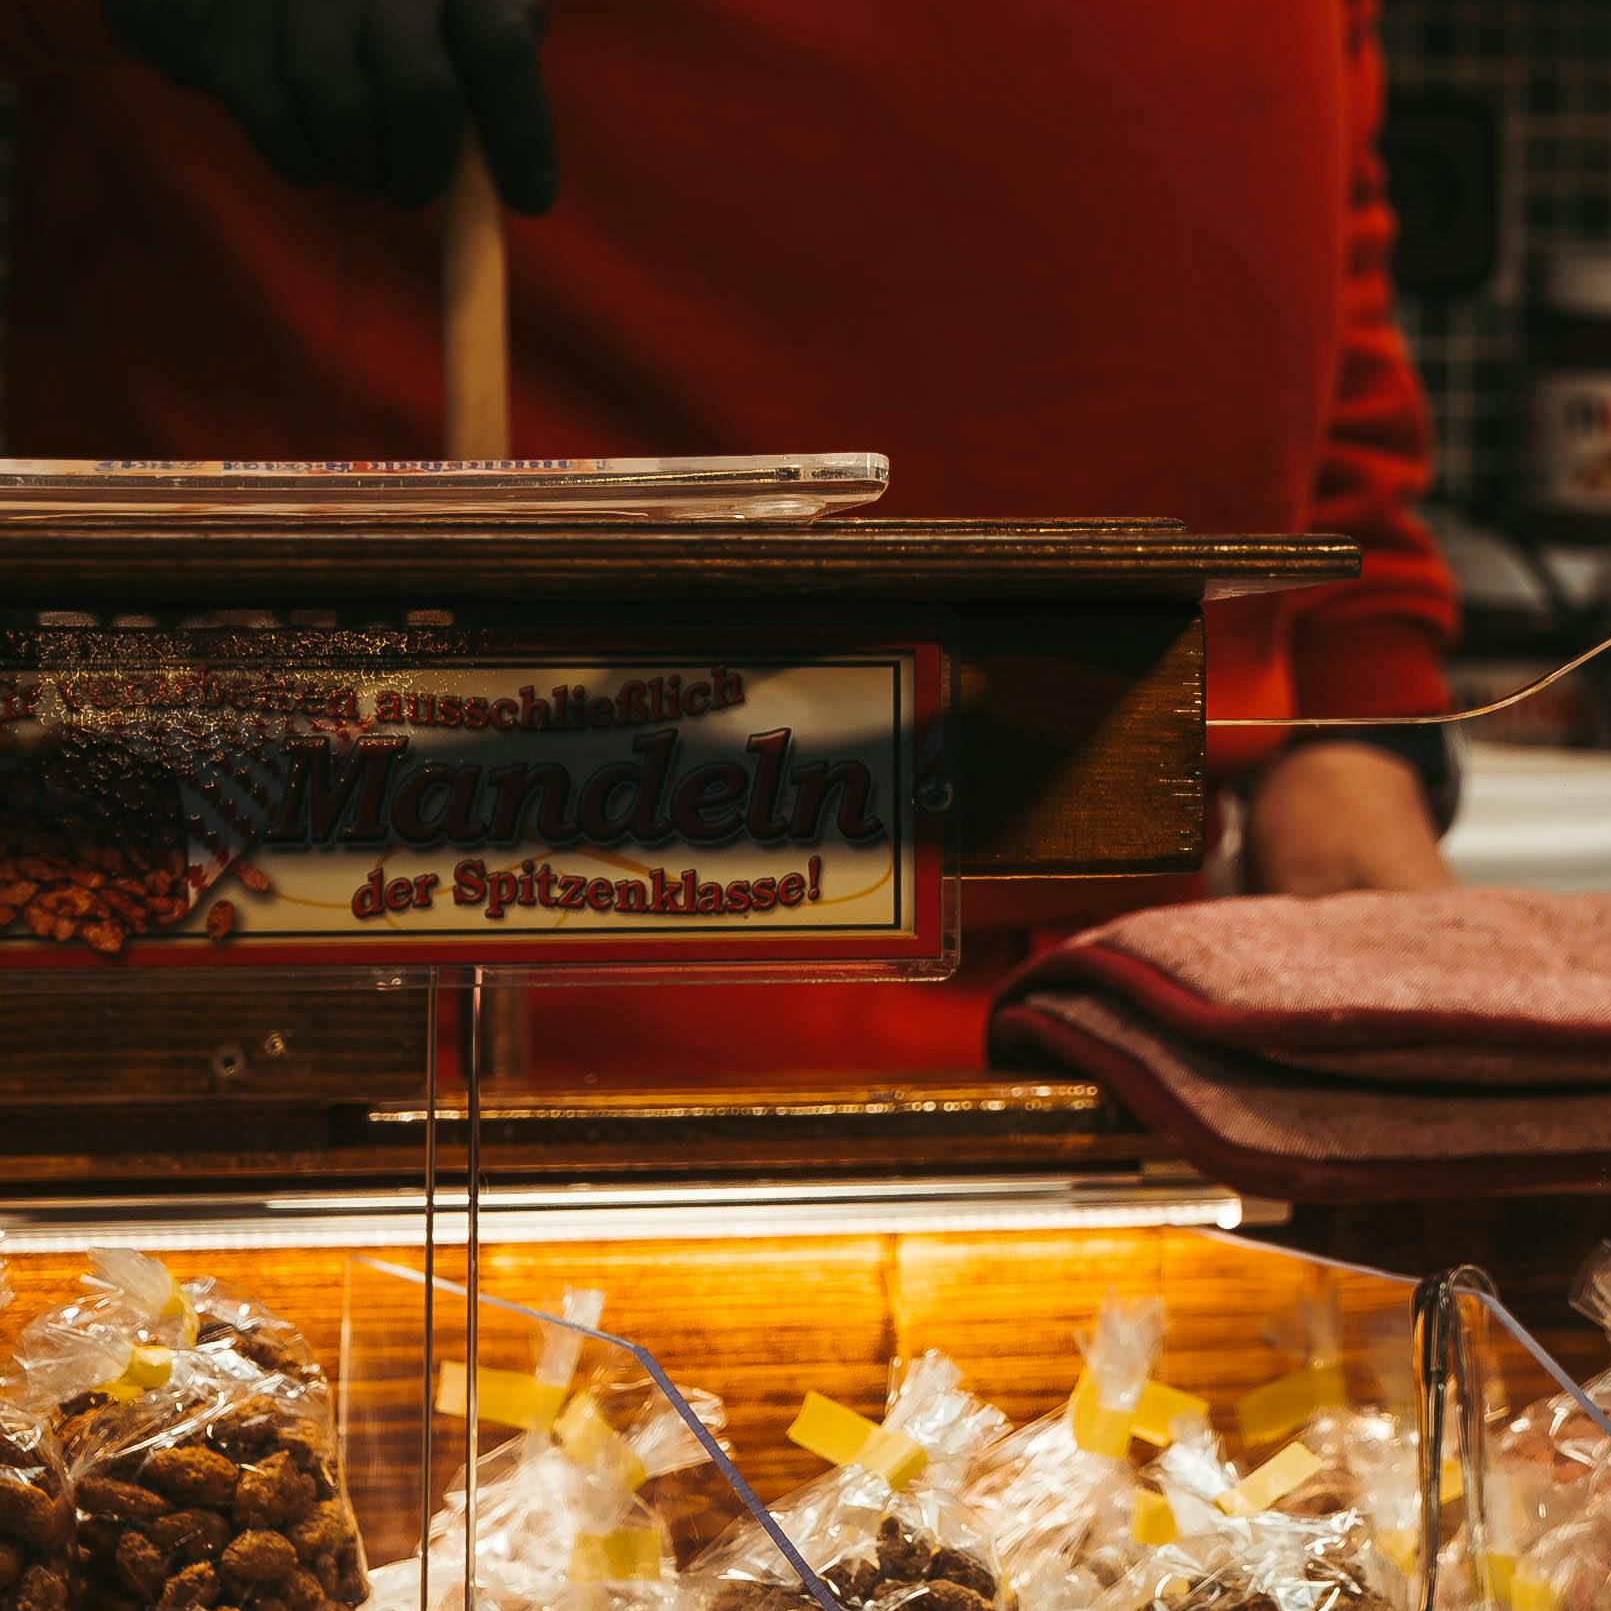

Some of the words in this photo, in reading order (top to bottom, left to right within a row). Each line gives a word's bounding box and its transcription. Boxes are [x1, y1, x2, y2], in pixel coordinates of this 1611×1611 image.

[374, 665, 747, 732] ausschließlich
[262, 727, 889, 849] Mandeln
[352, 868, 438, 920] der
[451, 855, 823, 920] Spitzenklasse!
